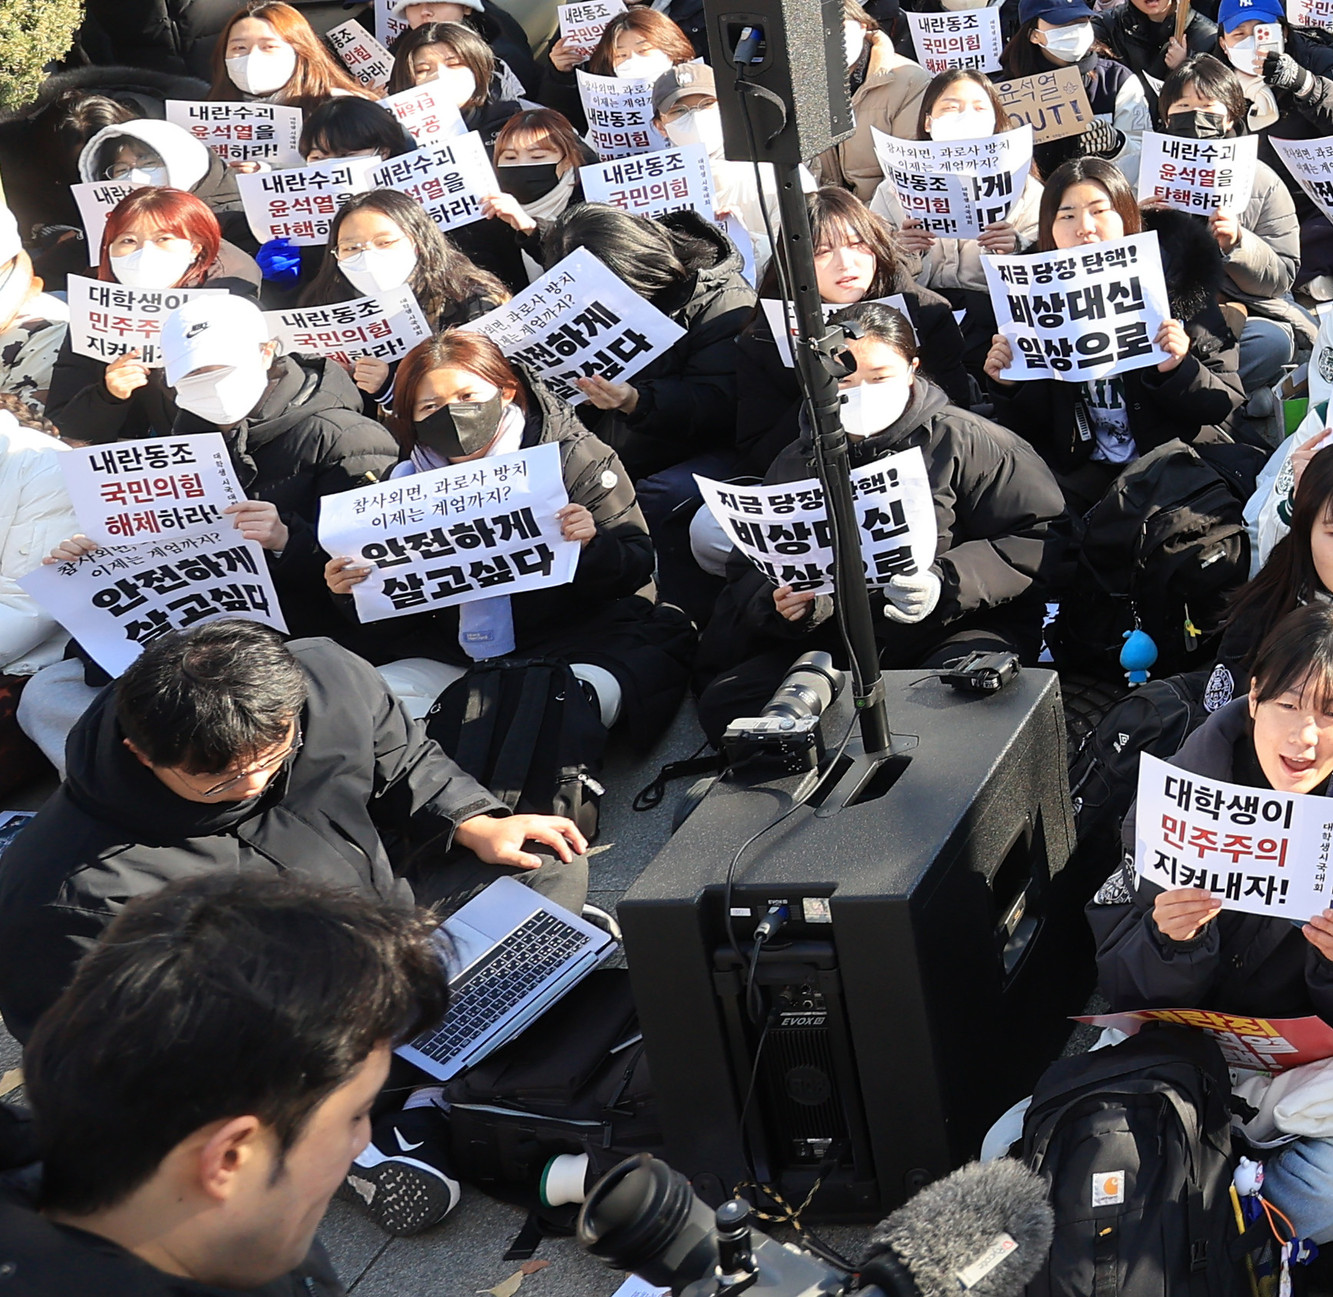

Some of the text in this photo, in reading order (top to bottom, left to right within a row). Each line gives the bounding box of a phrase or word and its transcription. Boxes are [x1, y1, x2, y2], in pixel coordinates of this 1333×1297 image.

[188, 105, 276, 124] 내란수괴
[1160, 139, 1237, 164] 내란수괴
[261, 168, 354, 194] 내란수괴
[1157, 162, 1234, 188] 윤석열을
[997, 243, 1139, 286] 지금 당장 탄핵!
[280, 298, 381, 331] 내란동조
[1007, 275, 1144, 331] 비상대신
[293, 319, 392, 351] 국민의힘
[1016, 319, 1156, 373] 일상으로
[90, 442, 197, 475] 내란동조
[100, 472, 204, 506] 국민의힘
[352, 460, 529, 515] 참사외면, 과로사 방치
[370, 486, 511, 530] 이제는 계엄까지?
[104, 504, 221, 539] 해체하라!
[360, 505, 543, 573] 안전하게
[91, 543, 260, 613] 안전하게
[380, 548, 556, 611] 살고싶다
[125, 583, 271, 647] 살고싶다
[1164, 775, 1295, 829] 대학생이
[1161, 813, 1288, 868] 민주주의
[1153, 848, 1289, 906] 지켜내자!
[781, 1017, 814, 1026] EVOX
